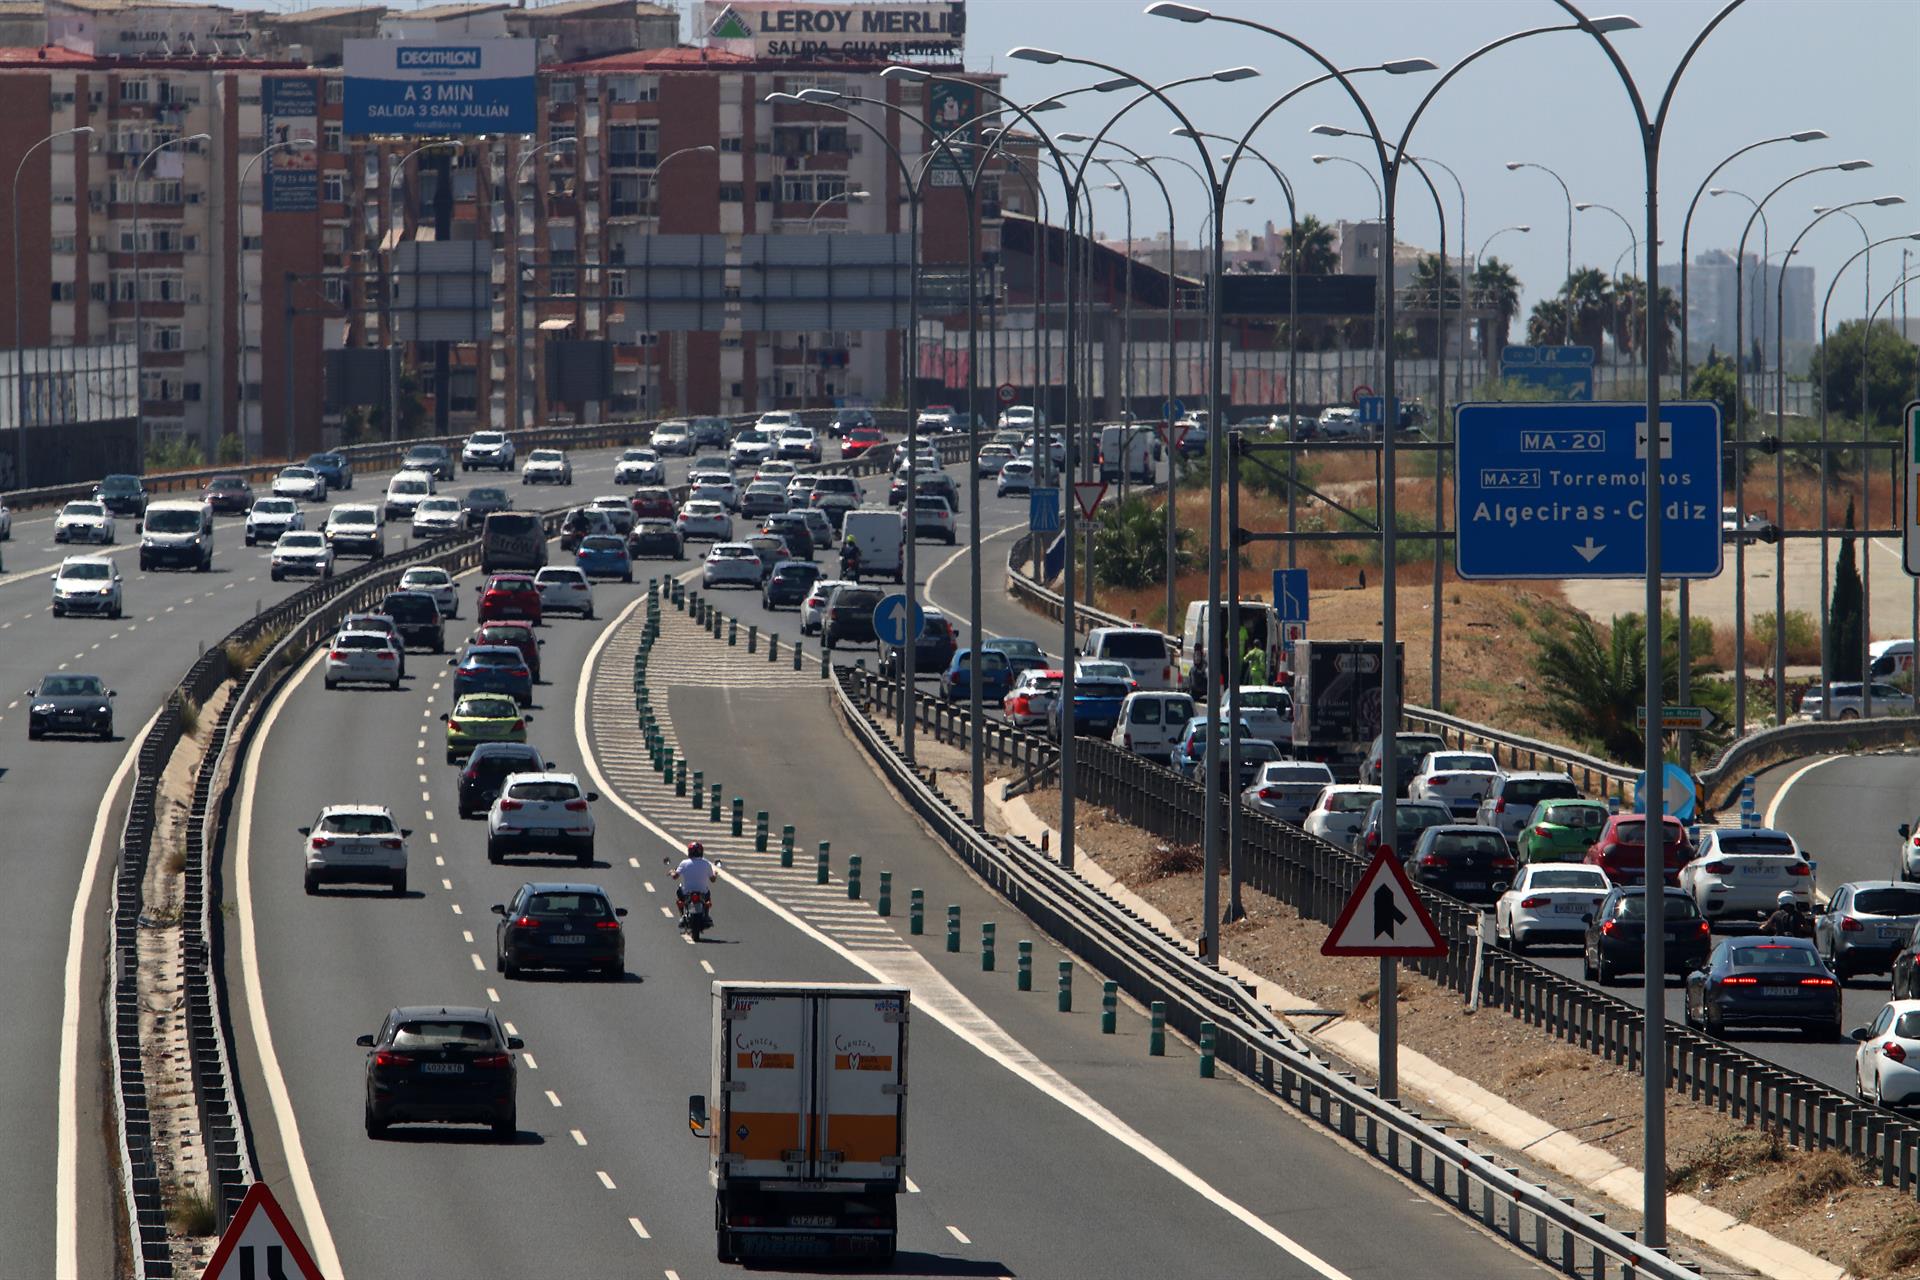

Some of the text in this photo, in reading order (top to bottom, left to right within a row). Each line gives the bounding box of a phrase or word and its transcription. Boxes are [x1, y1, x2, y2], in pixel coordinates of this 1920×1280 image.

[760, 10, 966, 34] LEROY MERLI
[120, 31, 168, 42] SALIDA
[767, 41, 829, 55] SALIDA
[400, 51, 476, 65] DECATHLON
[404, 85, 474, 101] A 3 MIN
[368, 100, 509, 118] SALIDA 3 SAN JULIÁN
[1524, 433, 1601, 450] MA-20
[1484, 470, 1692, 486] MA-21 Torremolnos
